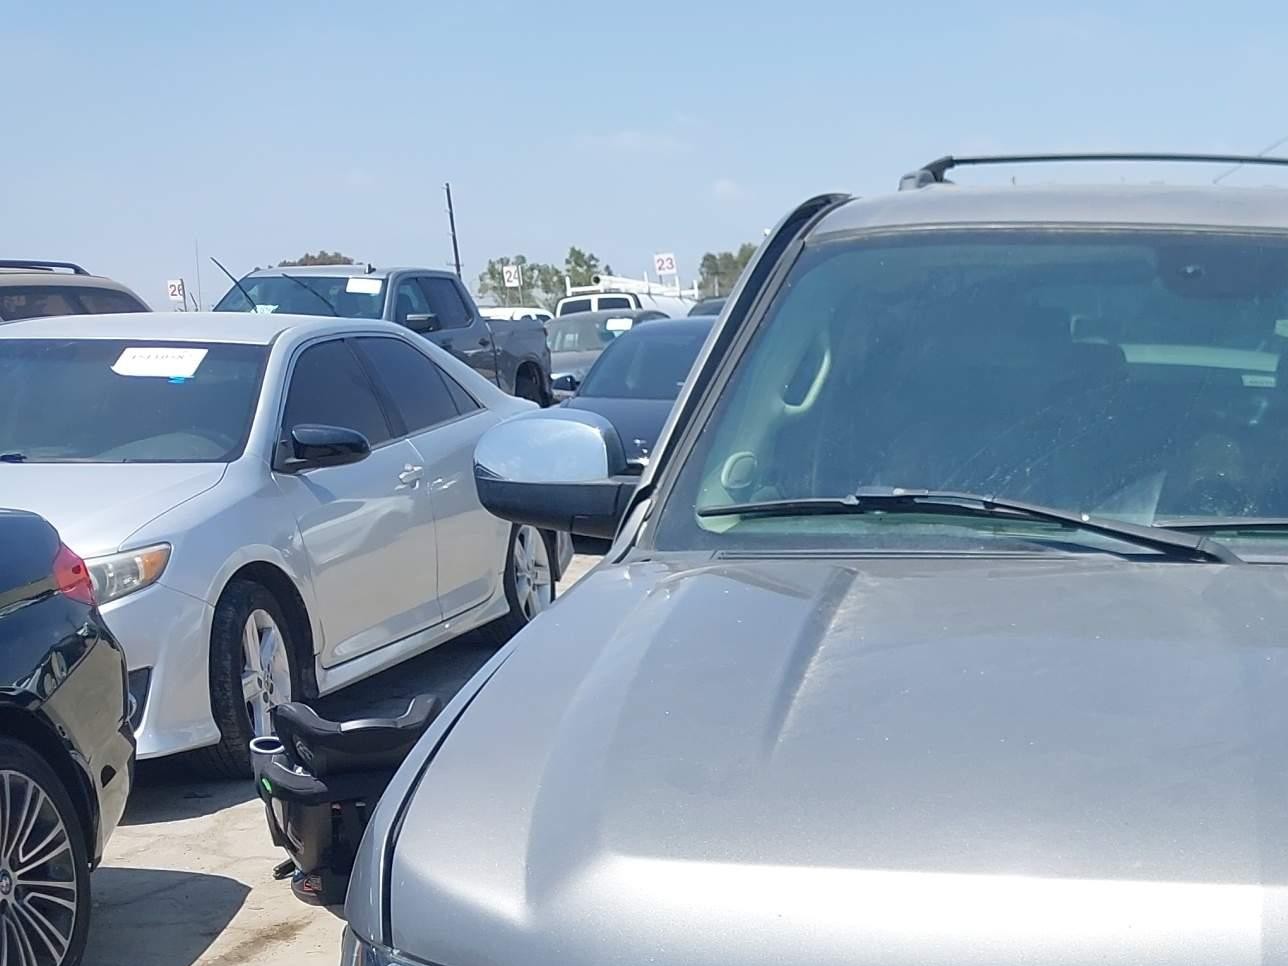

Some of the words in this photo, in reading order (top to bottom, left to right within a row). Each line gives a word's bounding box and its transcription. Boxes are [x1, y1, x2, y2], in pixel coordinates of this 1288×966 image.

[656, 257, 674, 272] 23
[505, 270, 519, 283] 24
[169, 283, 185, 297] 26
